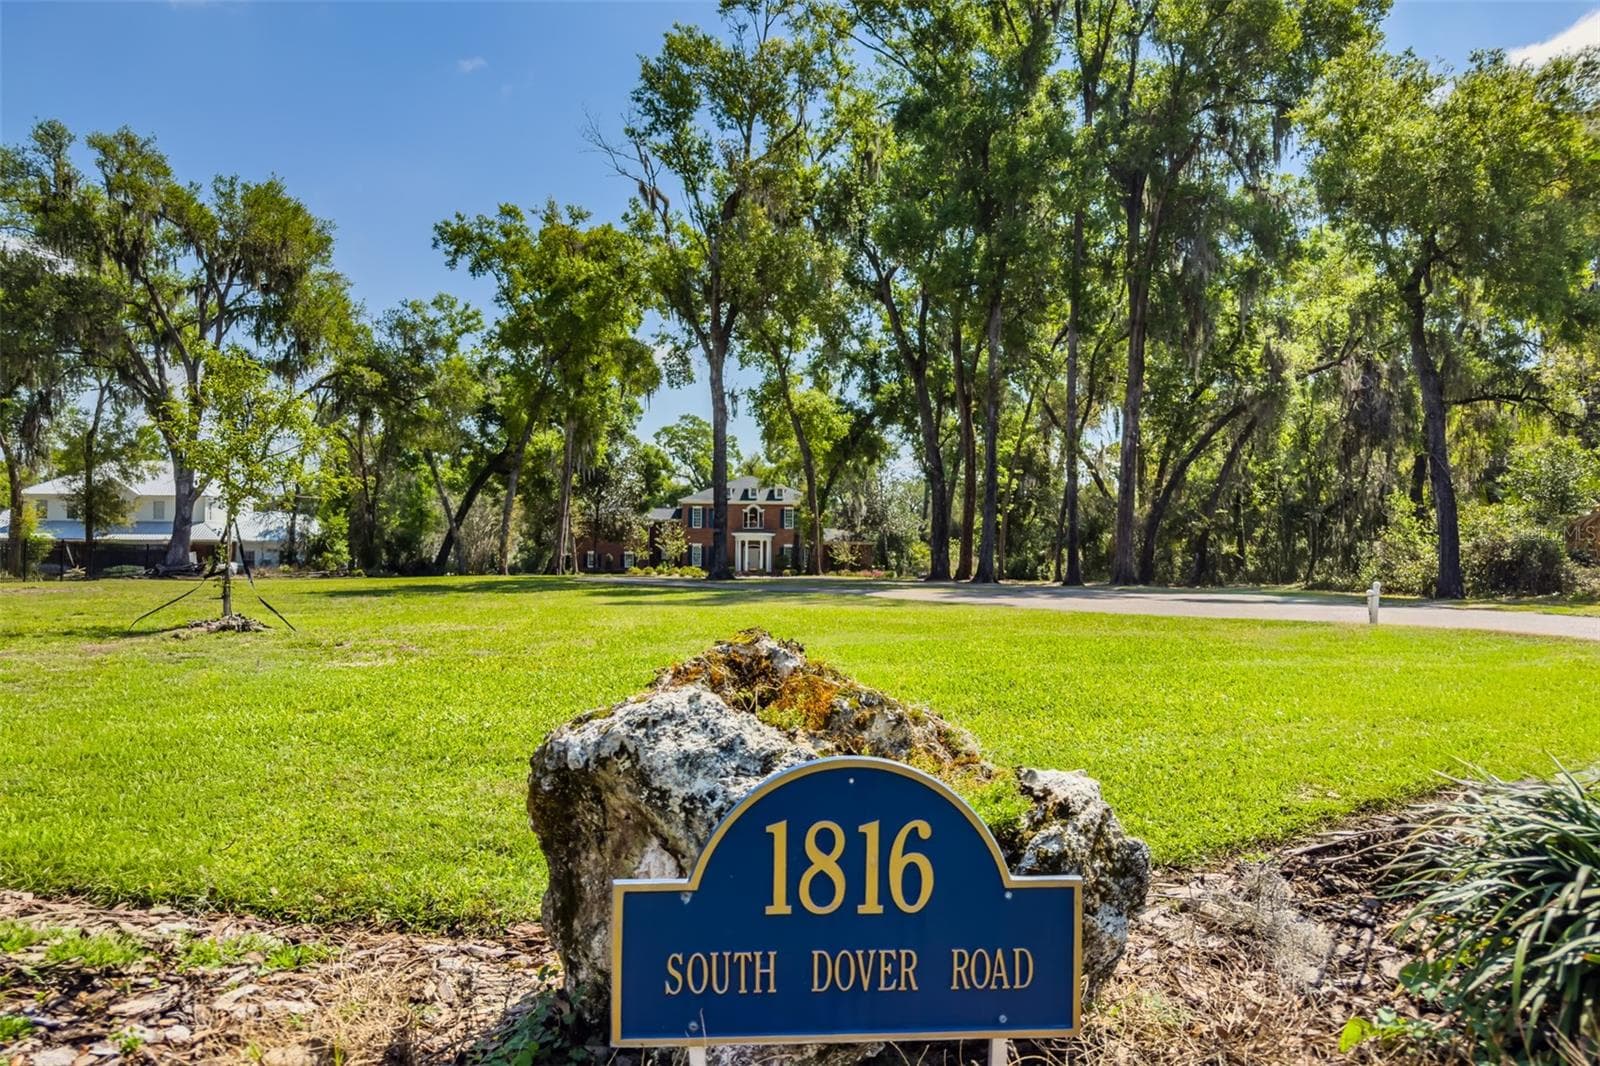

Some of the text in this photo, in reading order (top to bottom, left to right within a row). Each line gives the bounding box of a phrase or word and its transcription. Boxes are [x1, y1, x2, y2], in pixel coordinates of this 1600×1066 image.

[764, 819, 935, 915] 1816
[664, 947, 1035, 996] SOUTH DOVER ROAD
